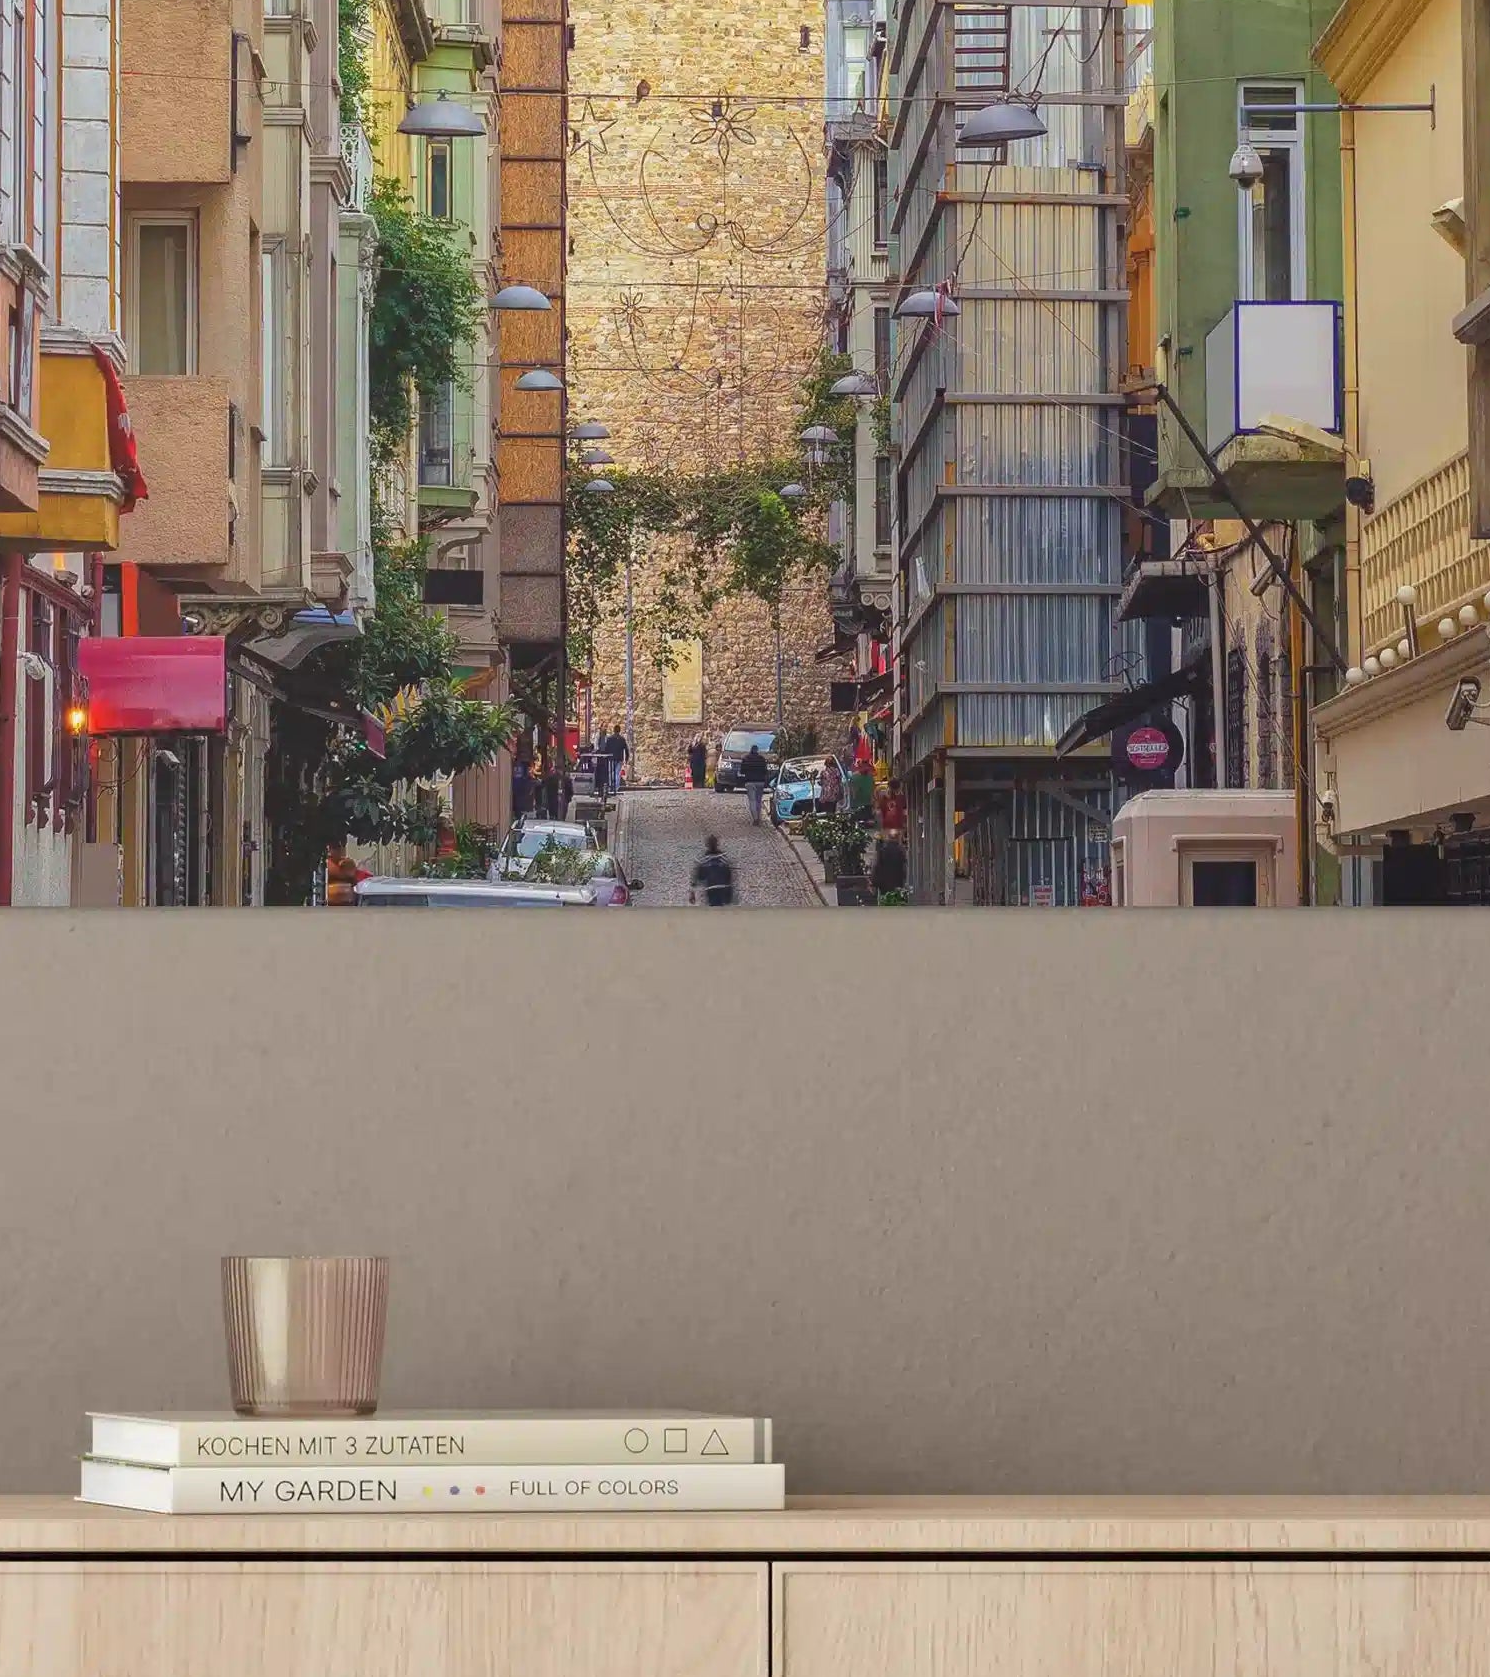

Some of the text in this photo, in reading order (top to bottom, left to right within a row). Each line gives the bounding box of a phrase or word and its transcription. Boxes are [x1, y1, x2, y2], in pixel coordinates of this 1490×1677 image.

[197, 1435, 464, 1456] KOCHEN MIT 3 ZUTATEN
[220, 1479, 679, 1502] MY GARDEN FULL OF COLORS
